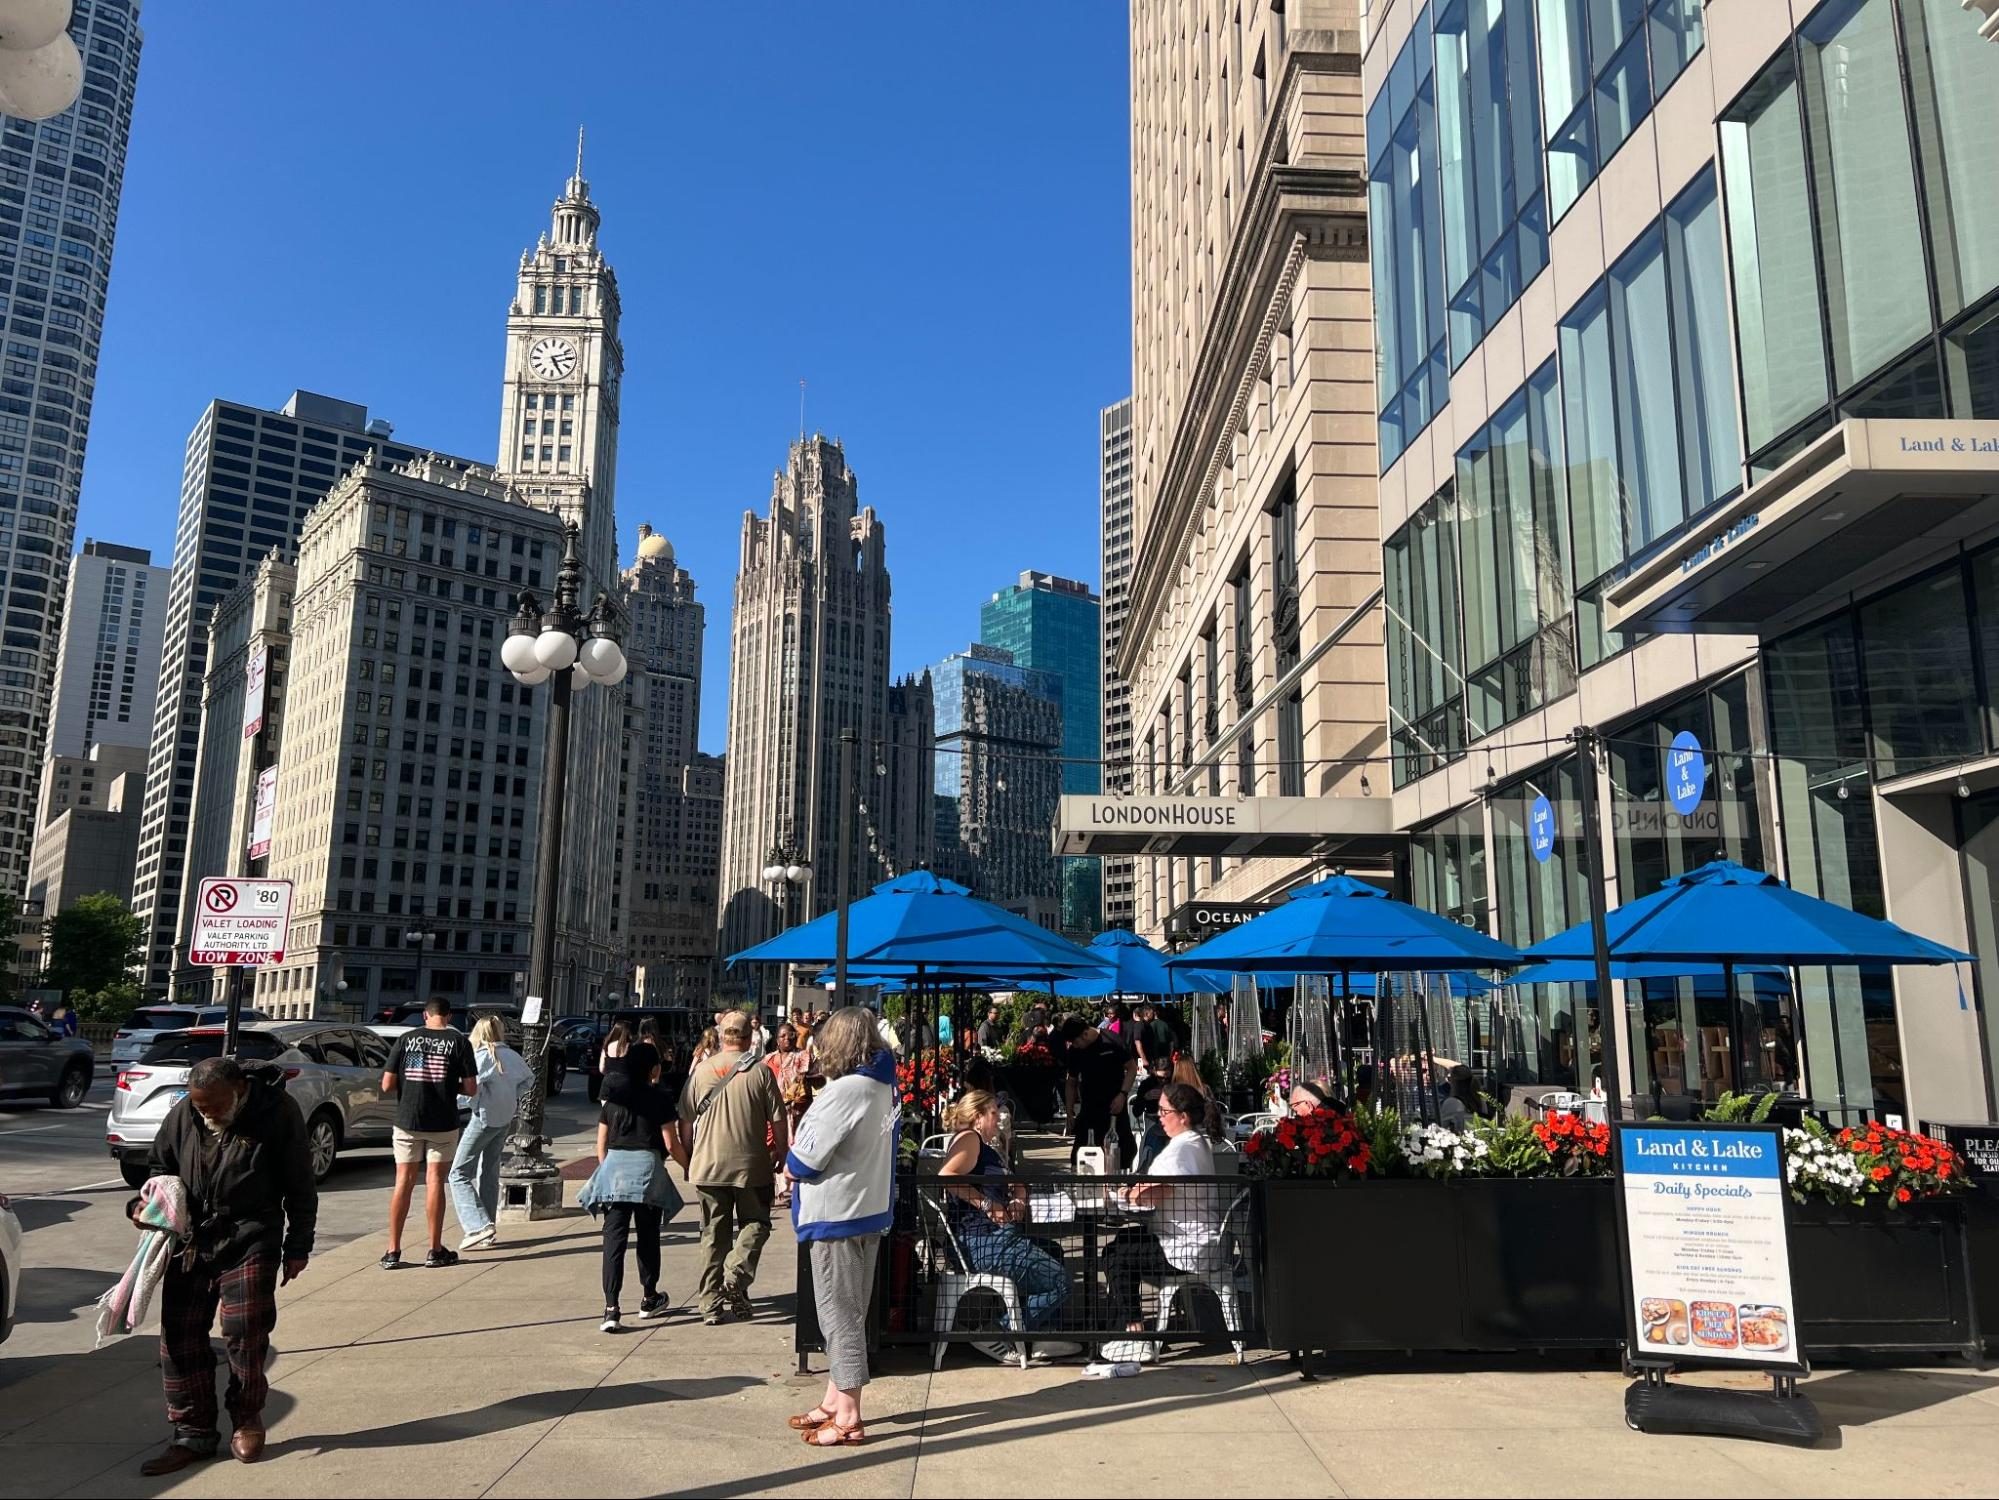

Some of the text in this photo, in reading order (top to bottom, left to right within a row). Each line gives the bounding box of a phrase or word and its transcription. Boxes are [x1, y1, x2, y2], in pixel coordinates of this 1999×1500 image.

[1900, 436, 1944, 452] Land
[1951, 437, 1965, 452] &
[1674, 745, 1694, 767] Land
[1681, 765, 1689, 781] &
[1677, 782, 1697, 800] Lake
[1534, 807, 1548, 823] Land
[1536, 836, 1549, 850] Lake
[256, 890, 279, 903] $80
[203, 919, 278, 928] VALET LOADING
[1196, 910, 1252, 924] OCEAN
[196, 952, 276, 963] TOW ZONE
[405, 1043, 452, 1055] WALLEN
[407, 1036, 454, 1048] MORGAN
[1636, 1138, 1763, 1159] Land & Lake
[1673, 1163, 1728, 1171] KITCHEN
[1653, 1181, 1753, 1200] Daily Specials
